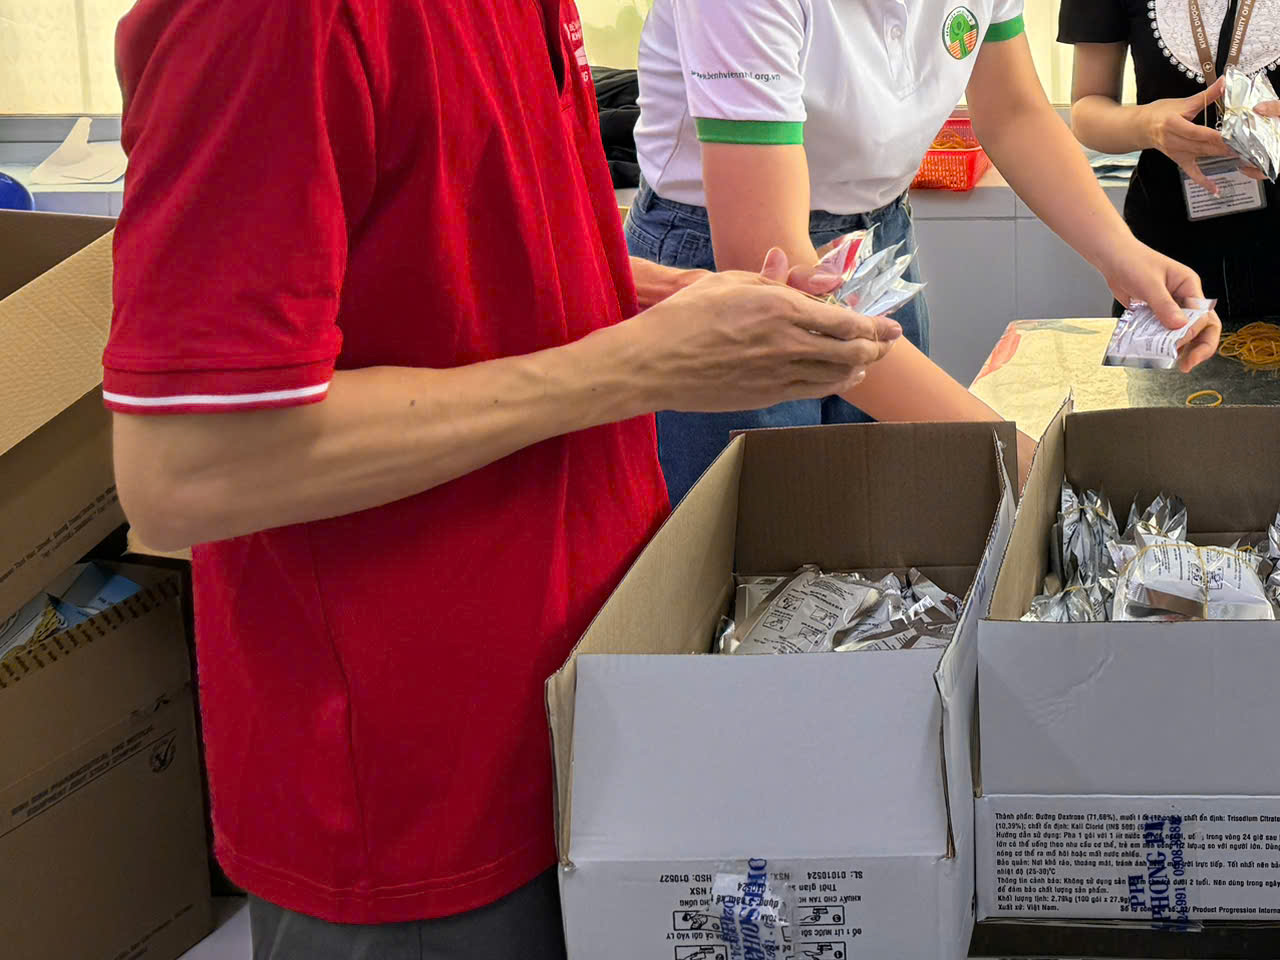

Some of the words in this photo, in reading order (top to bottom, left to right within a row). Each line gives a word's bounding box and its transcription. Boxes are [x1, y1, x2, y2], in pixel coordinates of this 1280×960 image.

[1230, 17, 1246, 56] UNIVERSITY
[1242, 5, 1250, 14] OF
[1195, 27, 1206, 48] KHOA
[1016, 812, 1034, 822] phần:
[1035, 813, 1056, 822] Đường
[1210, 815, 1226, 823] định:
[1053, 823, 1069, 832] định:
[996, 832, 1017, 840] Hướng
[1225, 834, 1241, 842] vòng
[1229, 843, 1248, 851] người
[996, 850, 1012, 858] nóng
[1227, 860, 1239, 868] Tốt
[1240, 860, 1255, 868] nhất
[660, 874, 689, 882] 010527
[692, 874, 712, 882] HSD:
[807, 871, 847, 879] 01010524
[850, 871, 863, 879] SL:
[997, 877, 1018, 885] Thông
[1063, 878, 1084, 886] Không
[1228, 879, 1245, 887] dùng
[1246, 879, 1263, 887] trong
[689, 887, 707, 895] NSX
[799, 883, 816, 891] gian
[819, 884, 837, 892] Thời
[839, 895, 862, 904] KHUẤY
[998, 894, 1012, 902] Khối
[1074, 896, 1089, 904] (100
[679, 899, 698, 908] UỐNG
[1026, 904, 1040, 912] Việt
[1218, 906, 1257, 914] Progression
[801, 929, 812, 937] SÔI
[814, 929, 832, 937] NƯỚC
[834, 928, 844, 936] LÍT
[852, 928, 862, 937] ĐỔ
[676, 933, 690, 941] VÀO
[705, 932, 714, 941] CẢ
